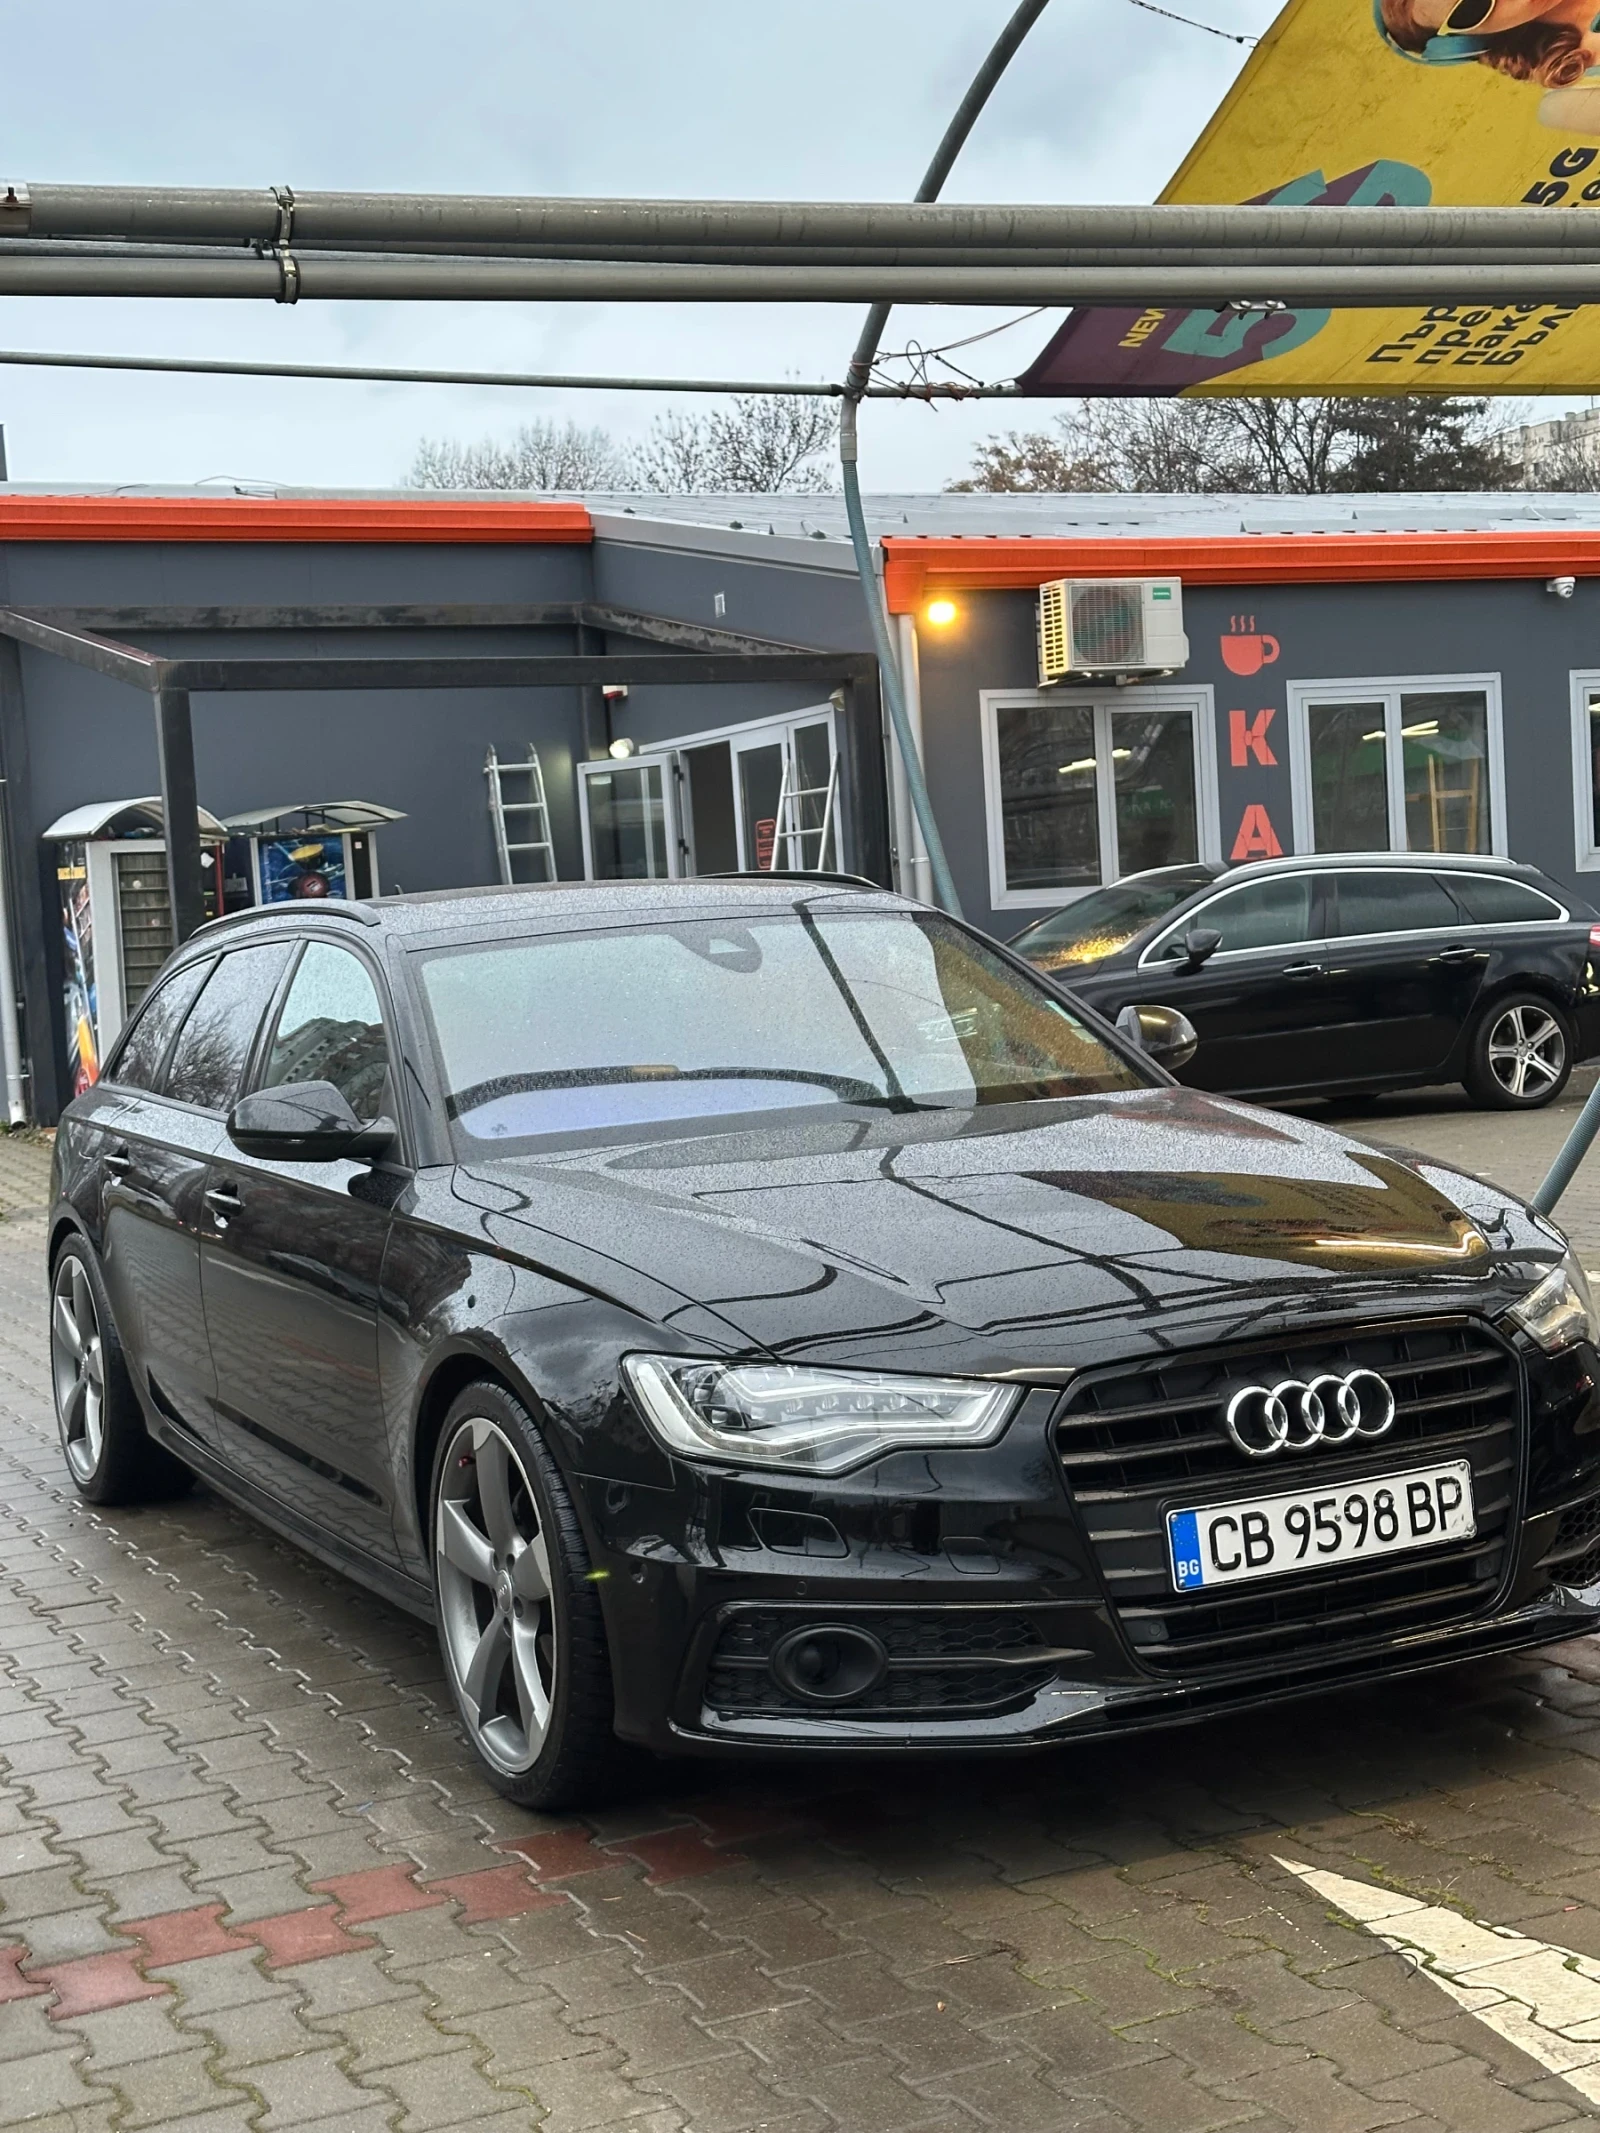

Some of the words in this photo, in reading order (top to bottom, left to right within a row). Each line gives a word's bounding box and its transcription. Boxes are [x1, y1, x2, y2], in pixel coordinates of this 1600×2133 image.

[1521, 147, 1599, 207] 5G
[1365, 306, 1460, 362] Пър
[1414, 305, 1507, 365] пре
[1480, 304, 1581, 365] Бъл
[1208, 1511, 1274, 1571] CB
[1284, 1488, 1399, 1559] 9598
[1405, 1475, 1462, 1537] BP
[1178, 1559, 1199, 1577] BG
